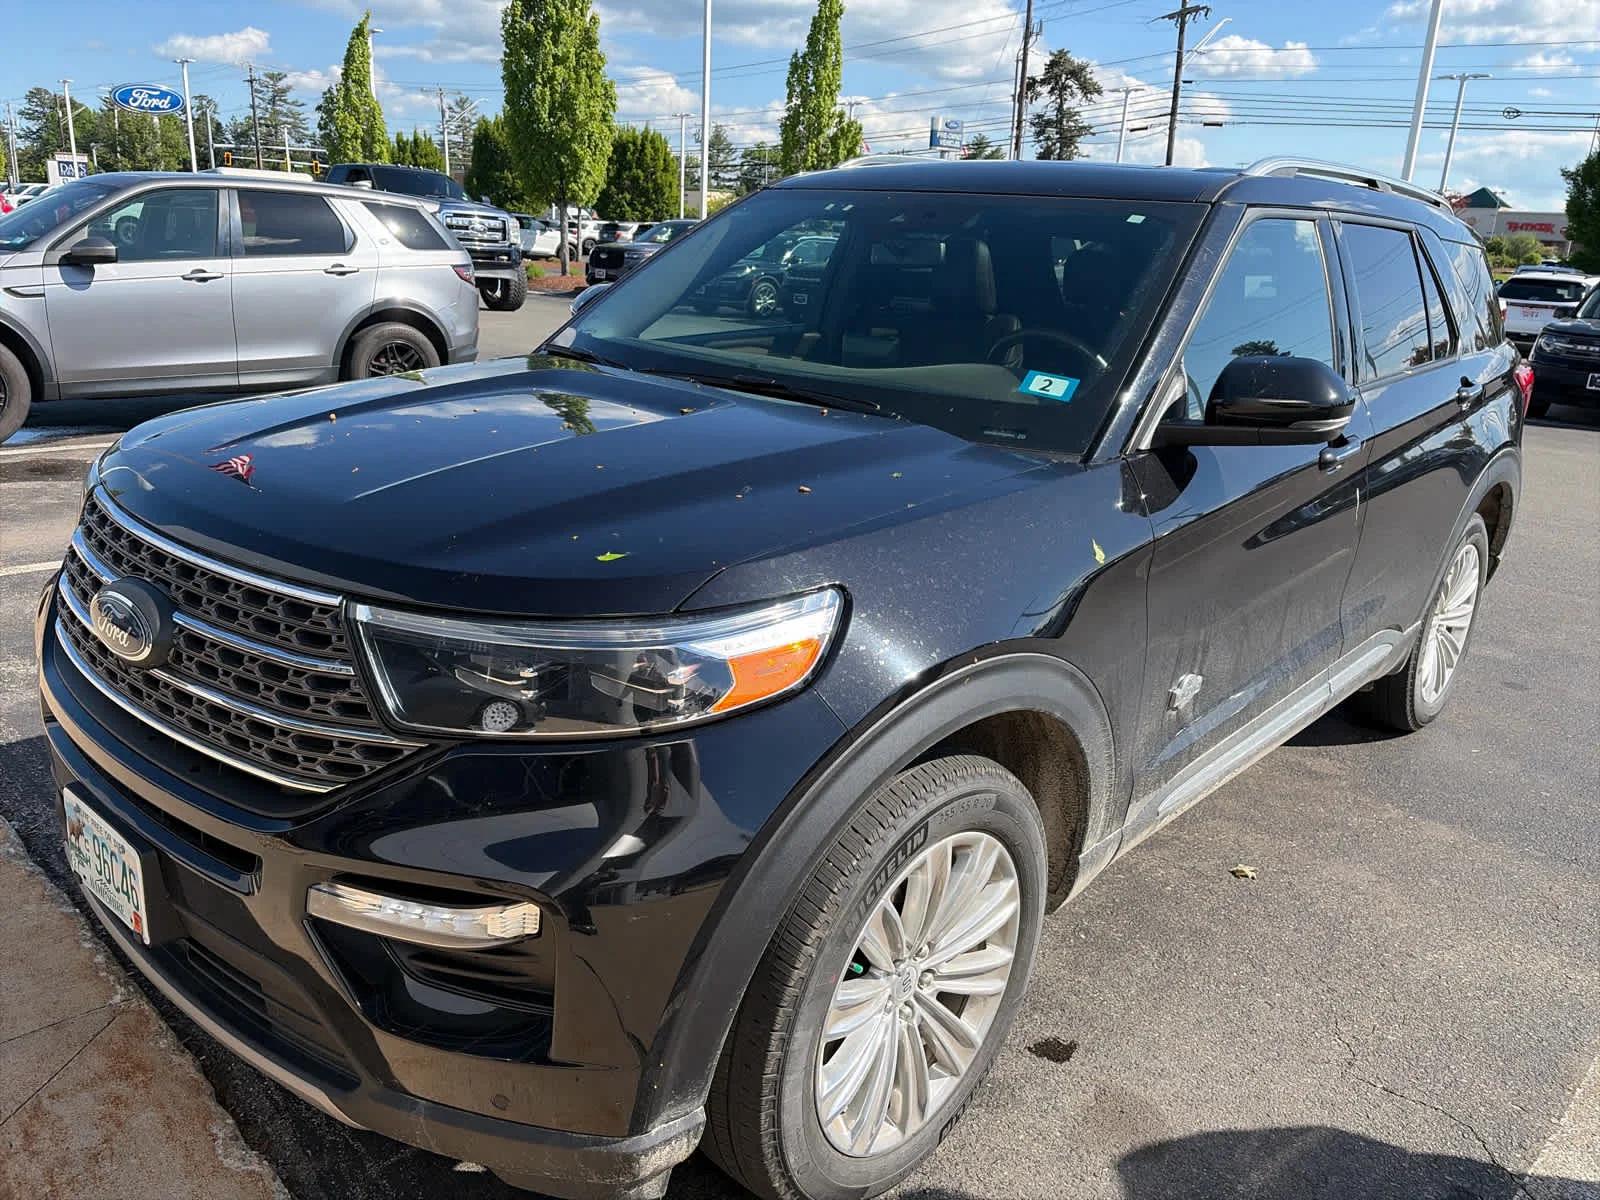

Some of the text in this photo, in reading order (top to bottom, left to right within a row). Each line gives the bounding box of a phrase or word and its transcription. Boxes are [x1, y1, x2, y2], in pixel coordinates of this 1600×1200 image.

[129, 89, 171, 108] Ford
[60, 163, 86, 175] DAS
[1039, 379, 1053, 392] 2
[97, 603, 132, 648] Ford
[92, 834, 140, 911] 96C46
[844, 826, 926, 934] MICHELIN
